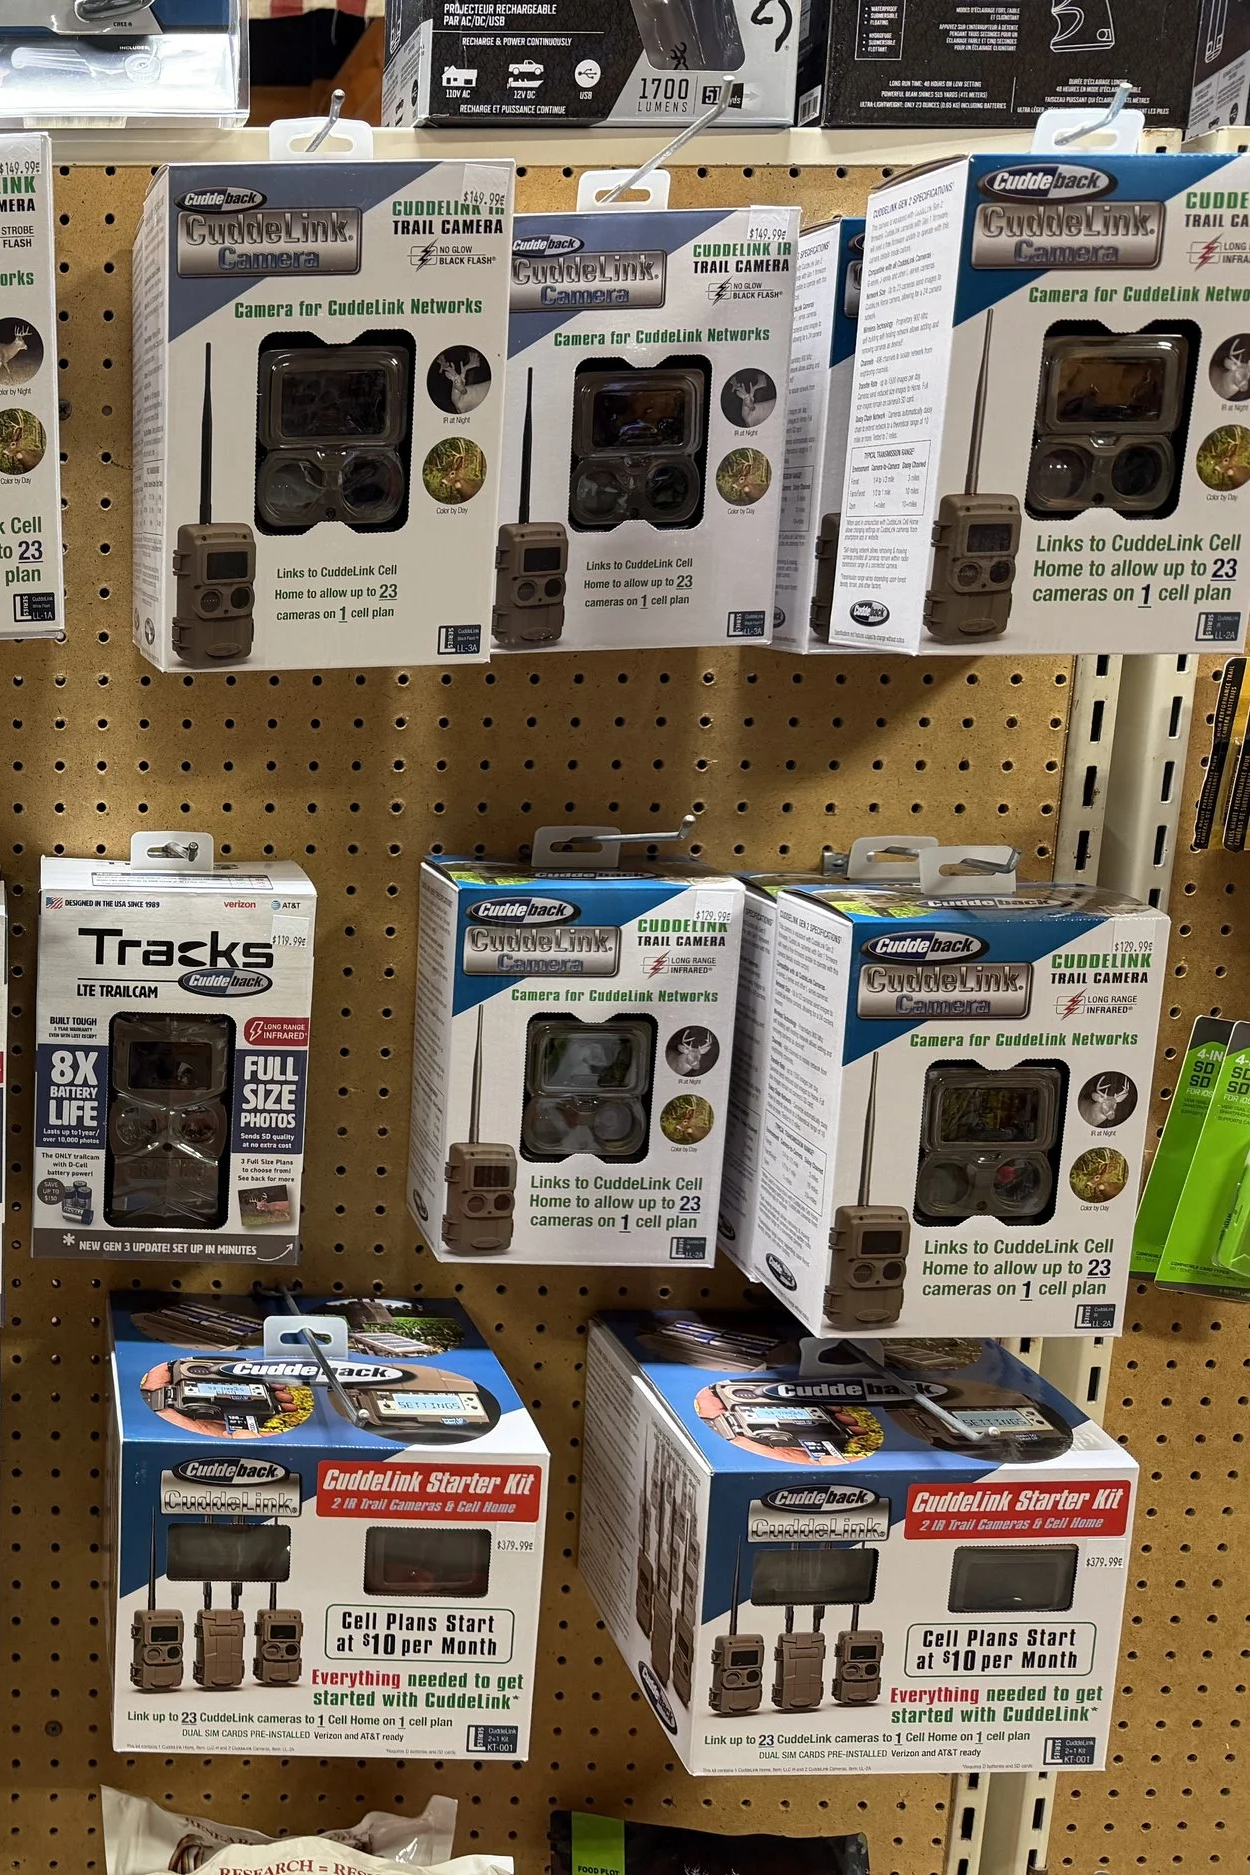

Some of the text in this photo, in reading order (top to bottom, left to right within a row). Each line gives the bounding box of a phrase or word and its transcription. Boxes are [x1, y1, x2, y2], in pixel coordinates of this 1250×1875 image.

[445, 3, 557, 14] PROJECTEUR RECHARGEABLE
[444, 16, 505, 26] PAR AC/DC/USB
[463, 37, 493, 45] RECHARGE
[503, 38, 525, 46] POWER
[527, 38, 572, 46] CONTINUOUSLY
[446, 90, 470, 98] 110V AC
[528, 91, 535, 99] DC
[579, 91, 592, 99] USB
[640, 78, 689, 100] 1700
[638, 102, 687, 113] LUMENS
[0, 225, 34, 236] STROBE
[3, 238, 32, 248] FLASH
[439, 245, 473, 255] NO GLOW
[439, 256, 464, 265] BLACK
[234, 298, 482, 318] Camera for CuddeLink Networks
[11, 516, 42, 534] Cell
[18, 540, 43, 563] 23
[5, 567, 41, 586] plan
[1214, 631, 1236, 640] LL-2A
[457, 643, 478, 653] LL-3A
[189, 975, 264, 987] Cuddeback
[910, 1032, 1138, 1048] Camera for CuddeLink Networks
[1193, 1061, 1215, 1074] SD
[1189, 1075, 1211, 1088] SD
[186, 1462, 279, 1478] Cuddeback
[322, 1469, 535, 1495] CuddeLink Starter Kit
[912, 1488, 1120, 1515] CuddeLink Starter Kit
[341, 1611, 495, 1633] Cell Plans Start
[336, 1632, 497, 1656] at $10 per Month
[312, 1668, 523, 1692] Everything needed to get
[313, 1690, 376, 1707] started
[382, 1690, 418, 1707] with
[182, 1728, 310, 1740] DUAL SIM CARDS PRE-INSTALLED
[487, 1743, 513, 1752] KT-001
[1063, 1755, 1090, 1764] KT-001
[219, 1860, 313, 1875] RESEARCH
[577, 1865, 619, 1875] FOOD PLOT
